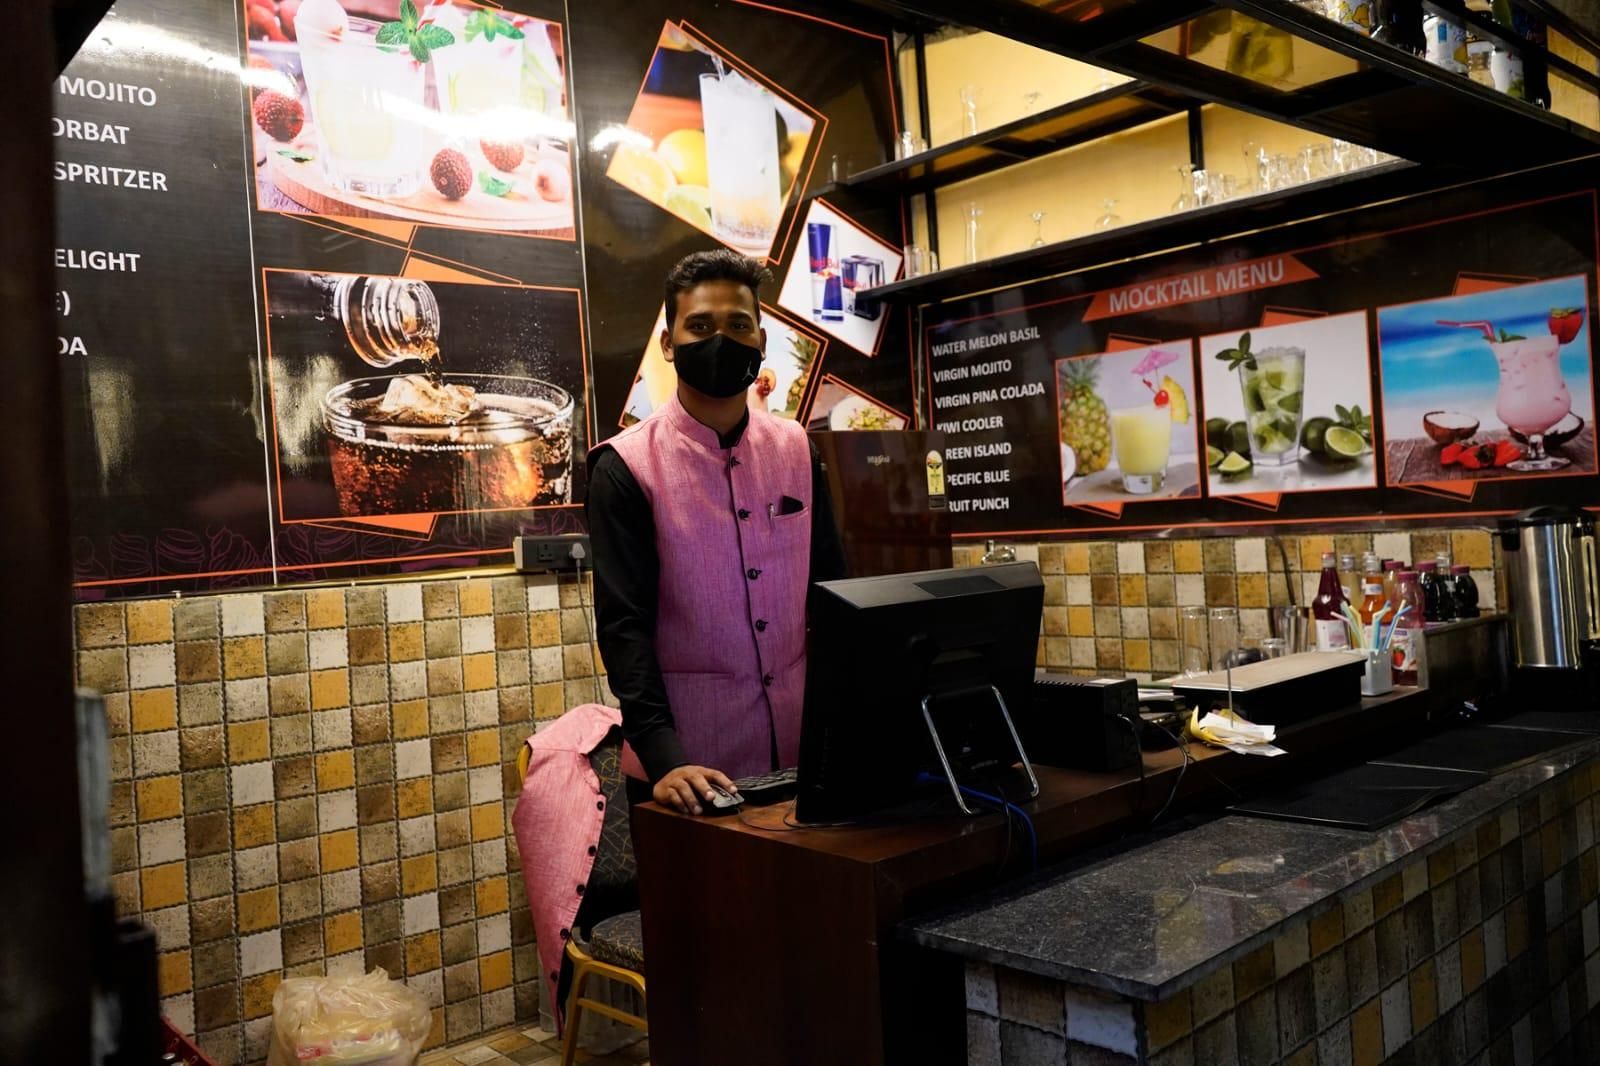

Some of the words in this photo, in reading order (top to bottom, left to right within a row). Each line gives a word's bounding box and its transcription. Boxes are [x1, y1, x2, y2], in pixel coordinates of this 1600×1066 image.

[60, 75, 157, 106] MOJITO
[52, 117, 130, 145] ORBAT
[54, 161, 168, 191] SPRITZER
[55, 249, 141, 272] ELIGHT
[1109, 276, 1210, 313] MOCKTAIL
[1216, 258, 1284, 293] MENU
[932, 340, 967, 357] WATER
[969, 332, 1007, 351] MELON
[1010, 326, 1041, 343] BASIL
[934, 366, 969, 383] VIRGIN
[971, 359, 1012, 377] MOJITO
[935, 393, 970, 409] VIRGIN
[972, 389, 999, 404] PINA
[1000, 382, 1045, 400] COLADA
[962, 416, 1004, 432] COOLER
[945, 446, 972, 460] REEN
[974, 442, 1012, 457] ISLAND
[984, 469, 1010, 483] BLUE
[972, 497, 1010, 511] PUNCH
